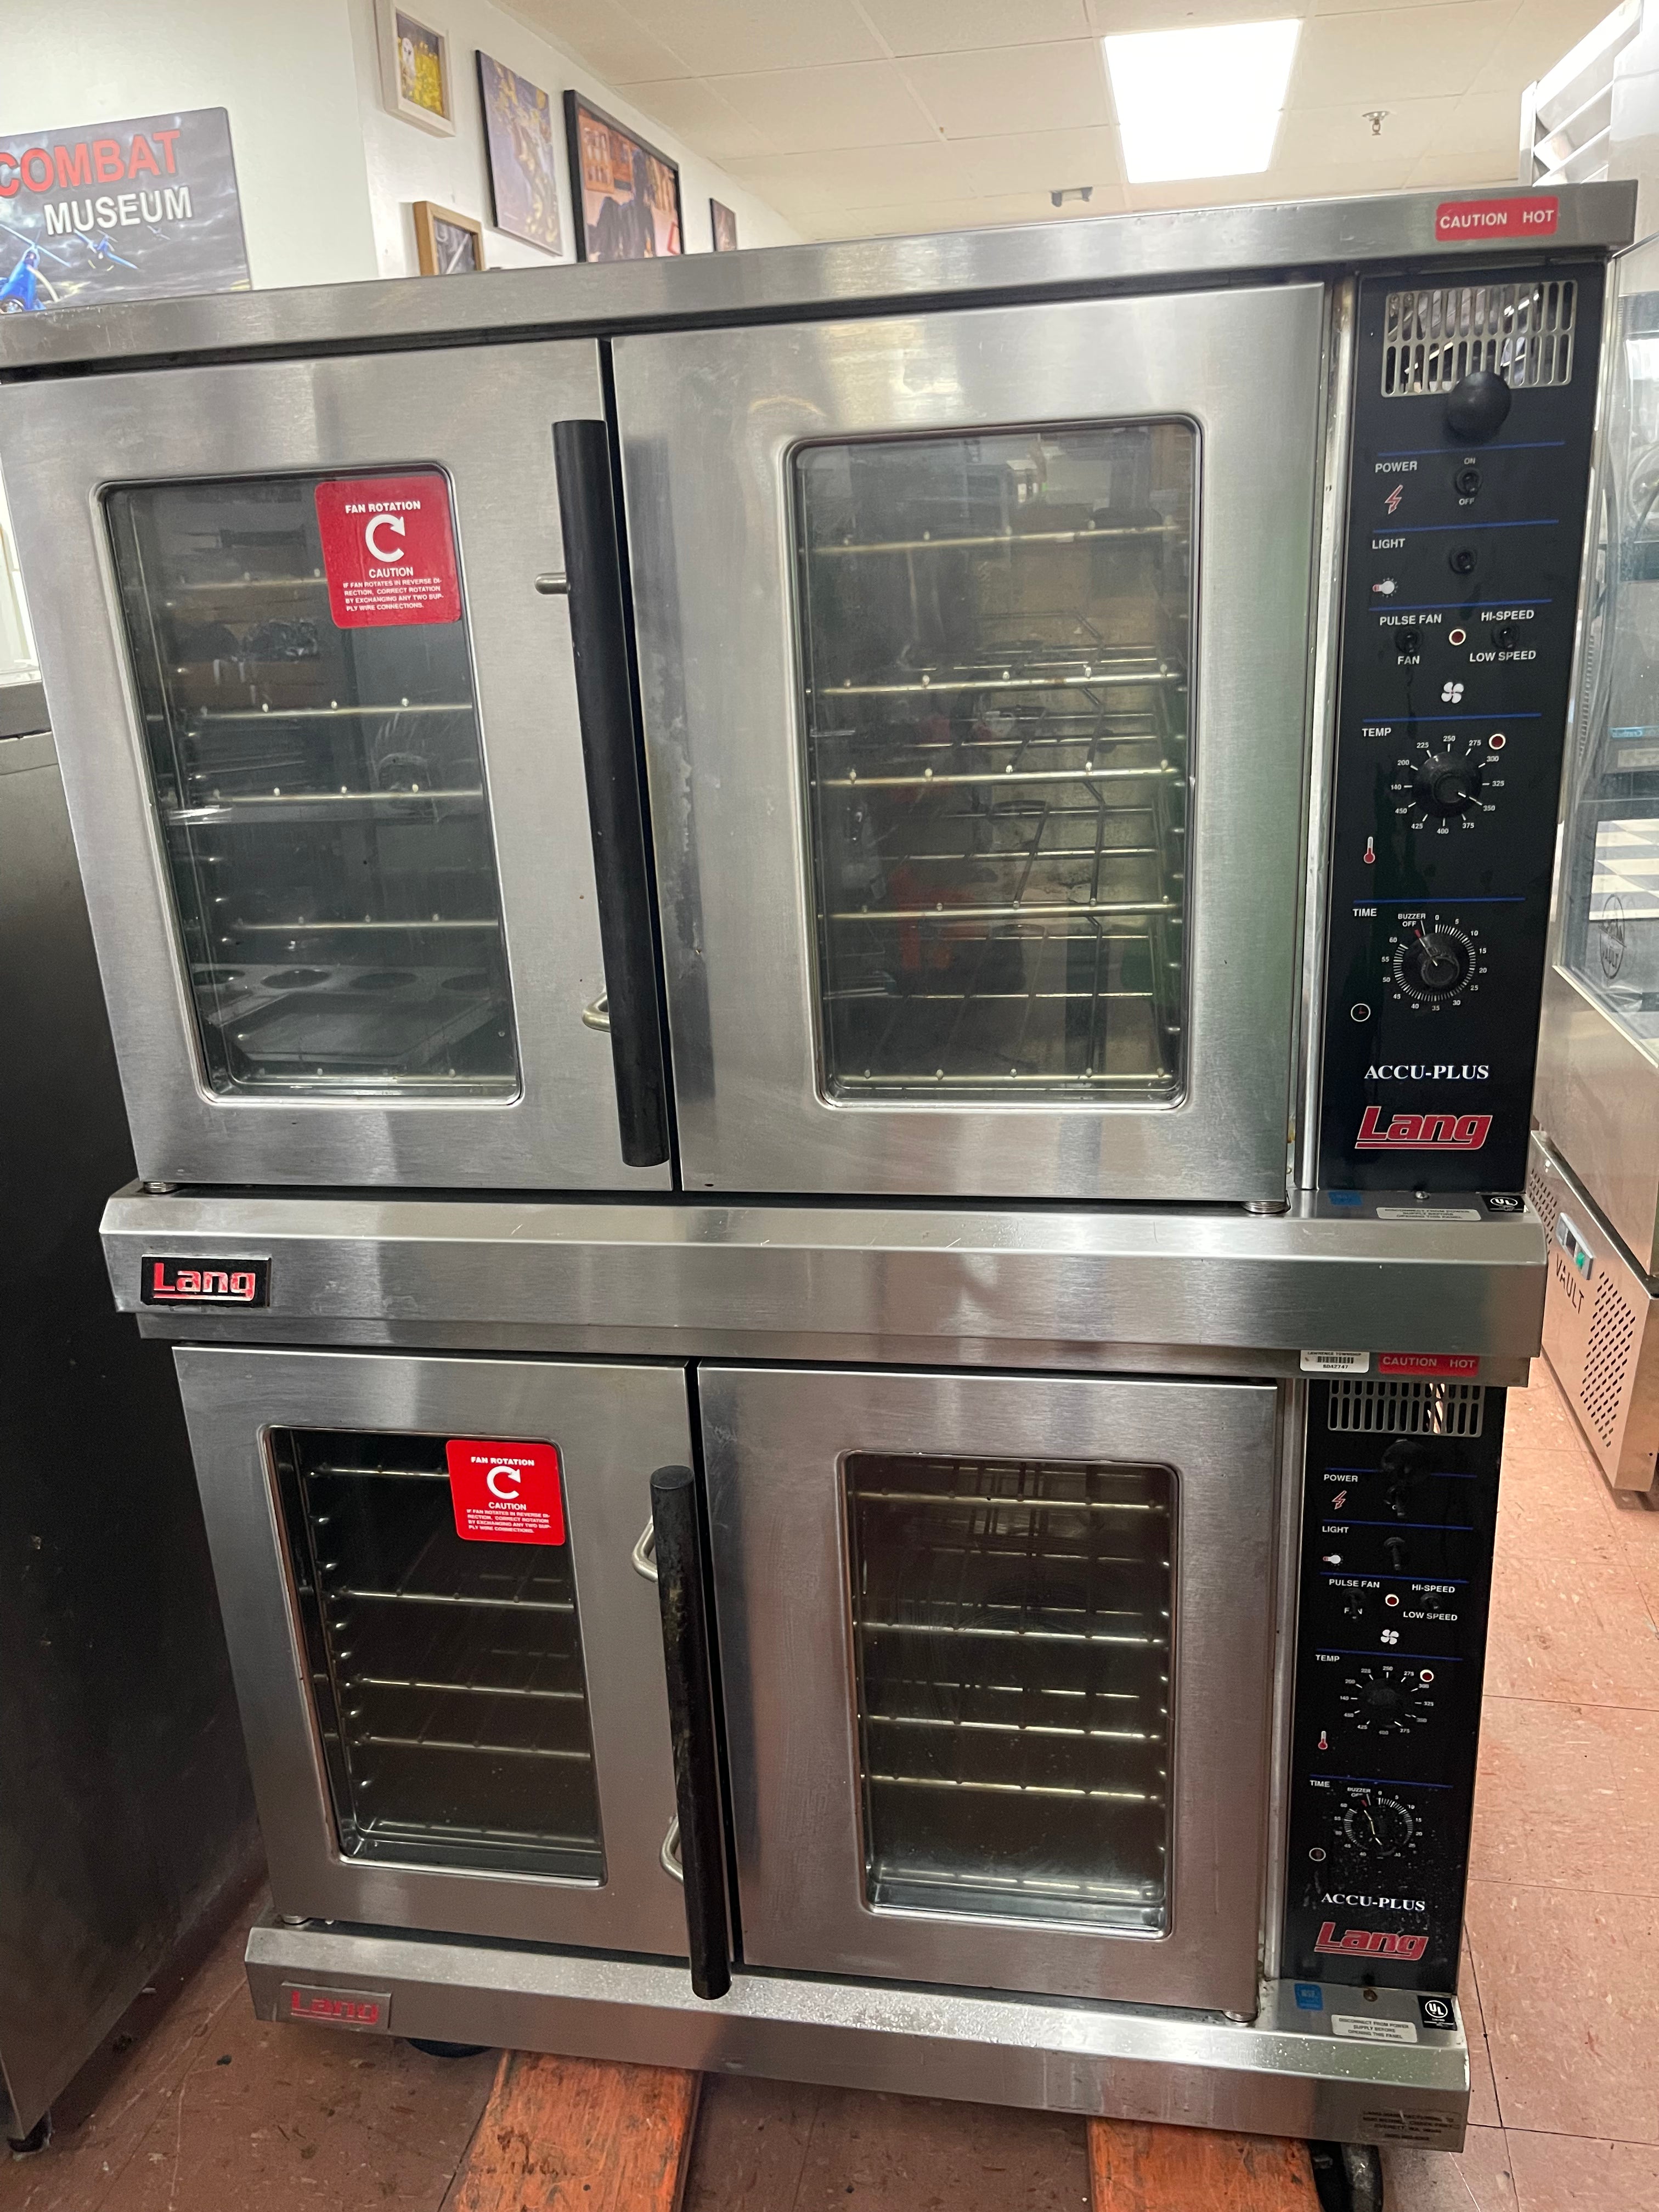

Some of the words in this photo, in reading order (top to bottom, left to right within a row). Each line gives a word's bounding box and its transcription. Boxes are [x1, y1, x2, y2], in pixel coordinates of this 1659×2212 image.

[0, 129, 180, 196] COMBAT
[44, 186, 193, 235] MUSEUM
[1440, 212, 1507, 229] CAUTION
[1522, 210, 1554, 223] HOT
[1375, 461, 1418, 473] POWER
[345, 504, 366, 514] FAN
[368, 500, 421, 512] ROTATION
[1372, 538, 1406, 550] LIGHT
[369, 567, 414, 579] CAUTION
[1380, 615, 1416, 625] PULSE
[1419, 613, 1442, 624] FAN
[1481, 610, 1534, 622] HI-SPEED
[1397, 656, 1420, 665] FAN
[1469, 652, 1496, 662] LOW
[1498, 650, 1536, 661] SPEED
[1362, 727, 1392, 737] TEMP
[1352, 908, 1377, 917] TIME
[1364, 1065, 1489, 1080] ACCU-PLUS
[1355, 1106, 1493, 1150] Lang
[153, 1262, 256, 1301] Lang
[1556, 1252, 1584, 1314] VAULT
[1382, 1356, 1437, 1367] CAUTION
[1449, 1359, 1476, 1369] HOT
[490, 1457, 534, 1466] ROTATION
[1323, 1474, 1358, 1482] POWER
[488, 1502, 527, 1510] CAUTION
[1329, 1579, 1359, 1587] PULSE
[1412, 1584, 1455, 1593] HI-SPEED
[1426, 1612, 1458, 1621] SPEED
[1310, 1780, 1330, 1788] TIME
[1321, 1893, 1425, 1911] ACCU-PLUS
[1314, 1922, 1429, 1961] Lang
[291, 1990, 379, 2024] Lang
[1429, 2003, 1444, 2015] UL
